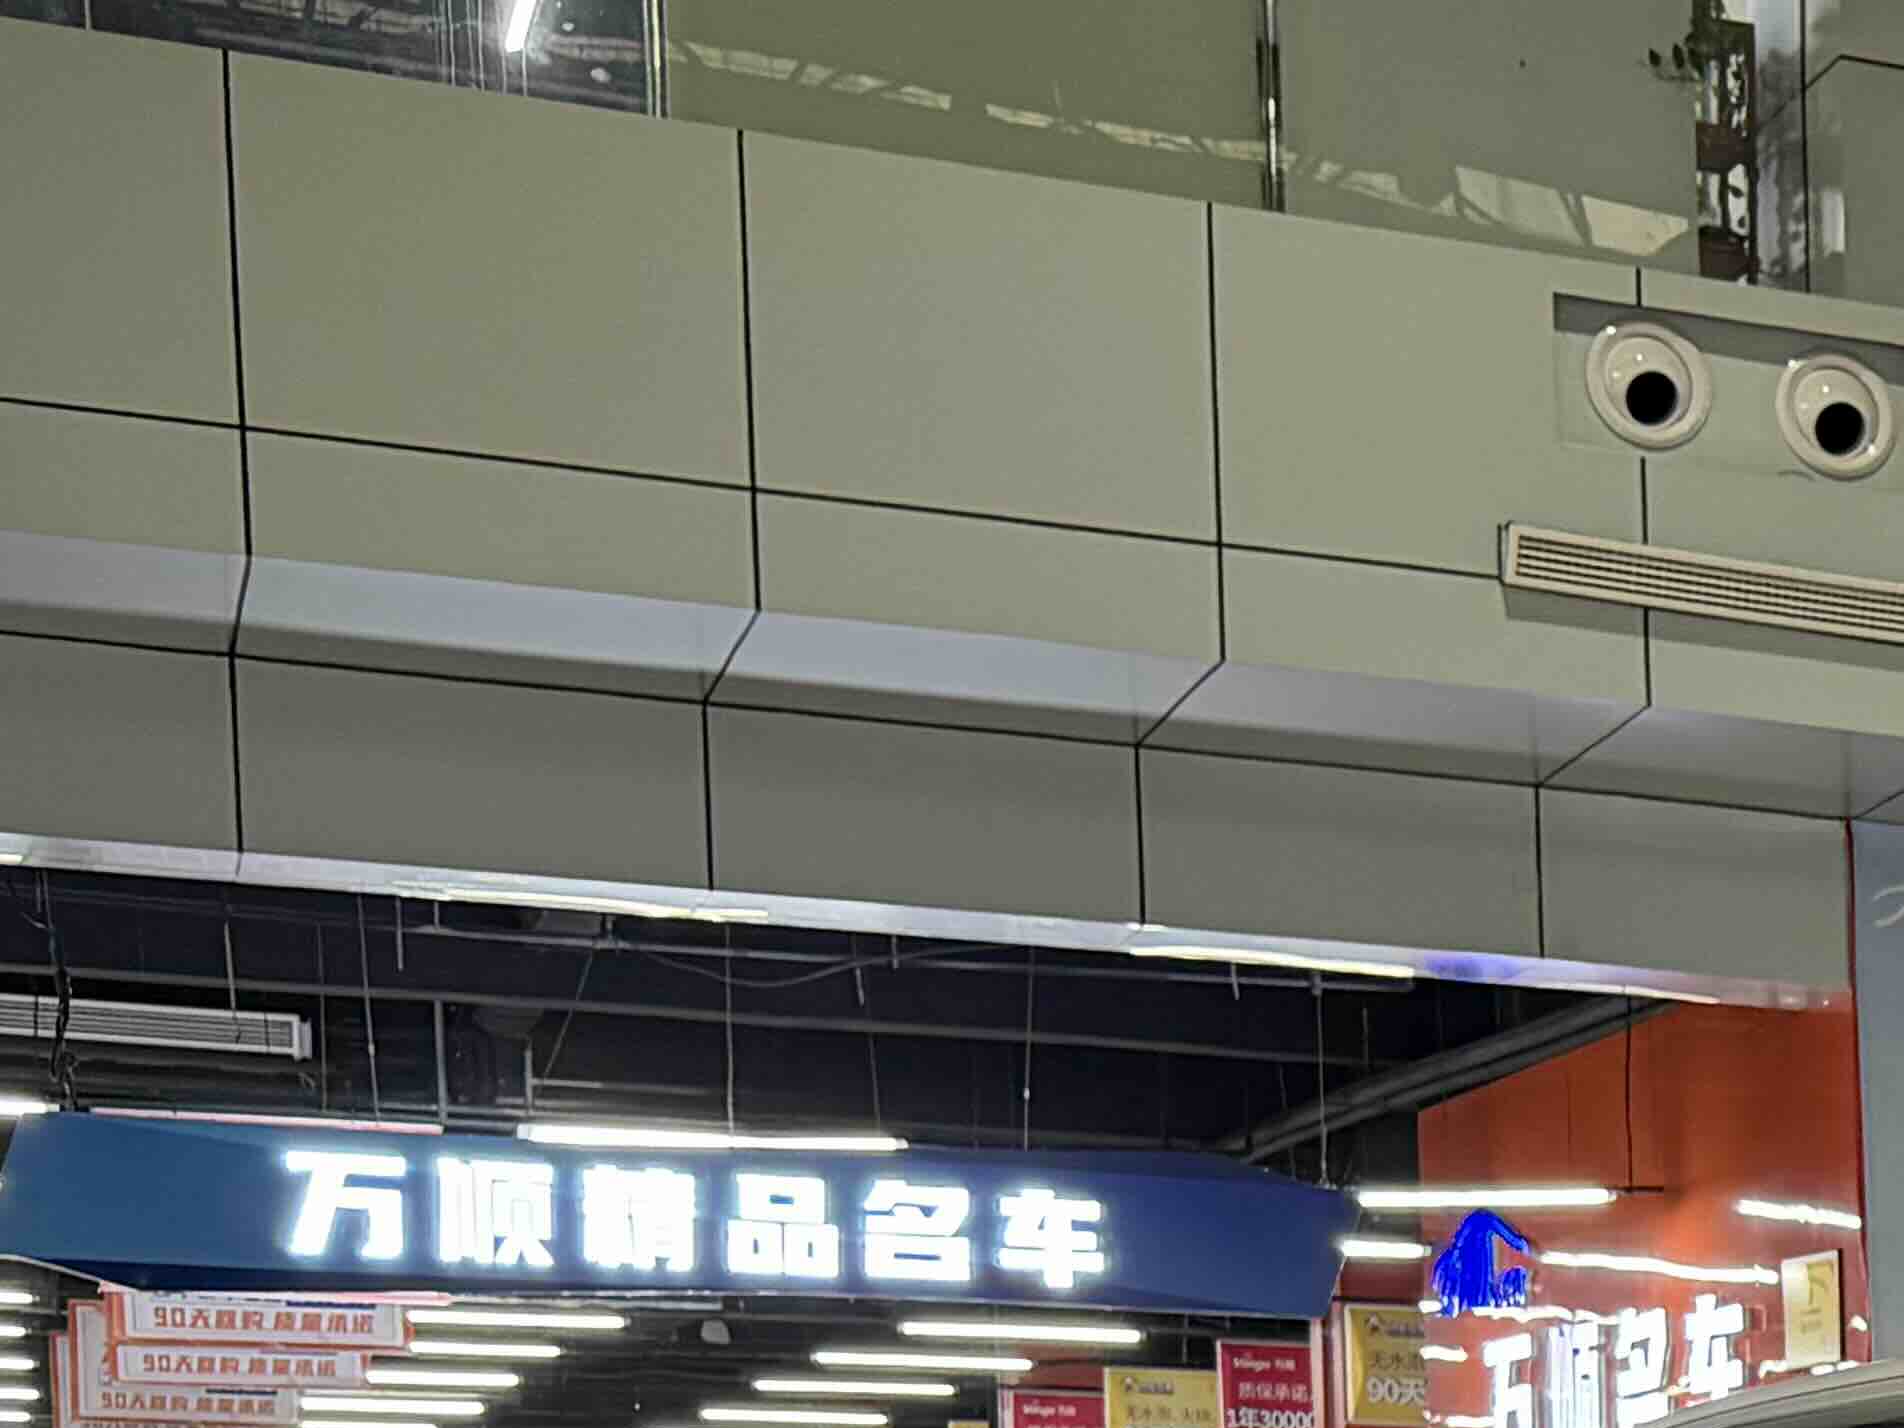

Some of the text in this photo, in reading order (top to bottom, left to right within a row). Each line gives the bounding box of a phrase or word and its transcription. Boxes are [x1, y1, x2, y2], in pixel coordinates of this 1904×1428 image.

[284, 1149, 1108, 1289] 万顺精品名车
